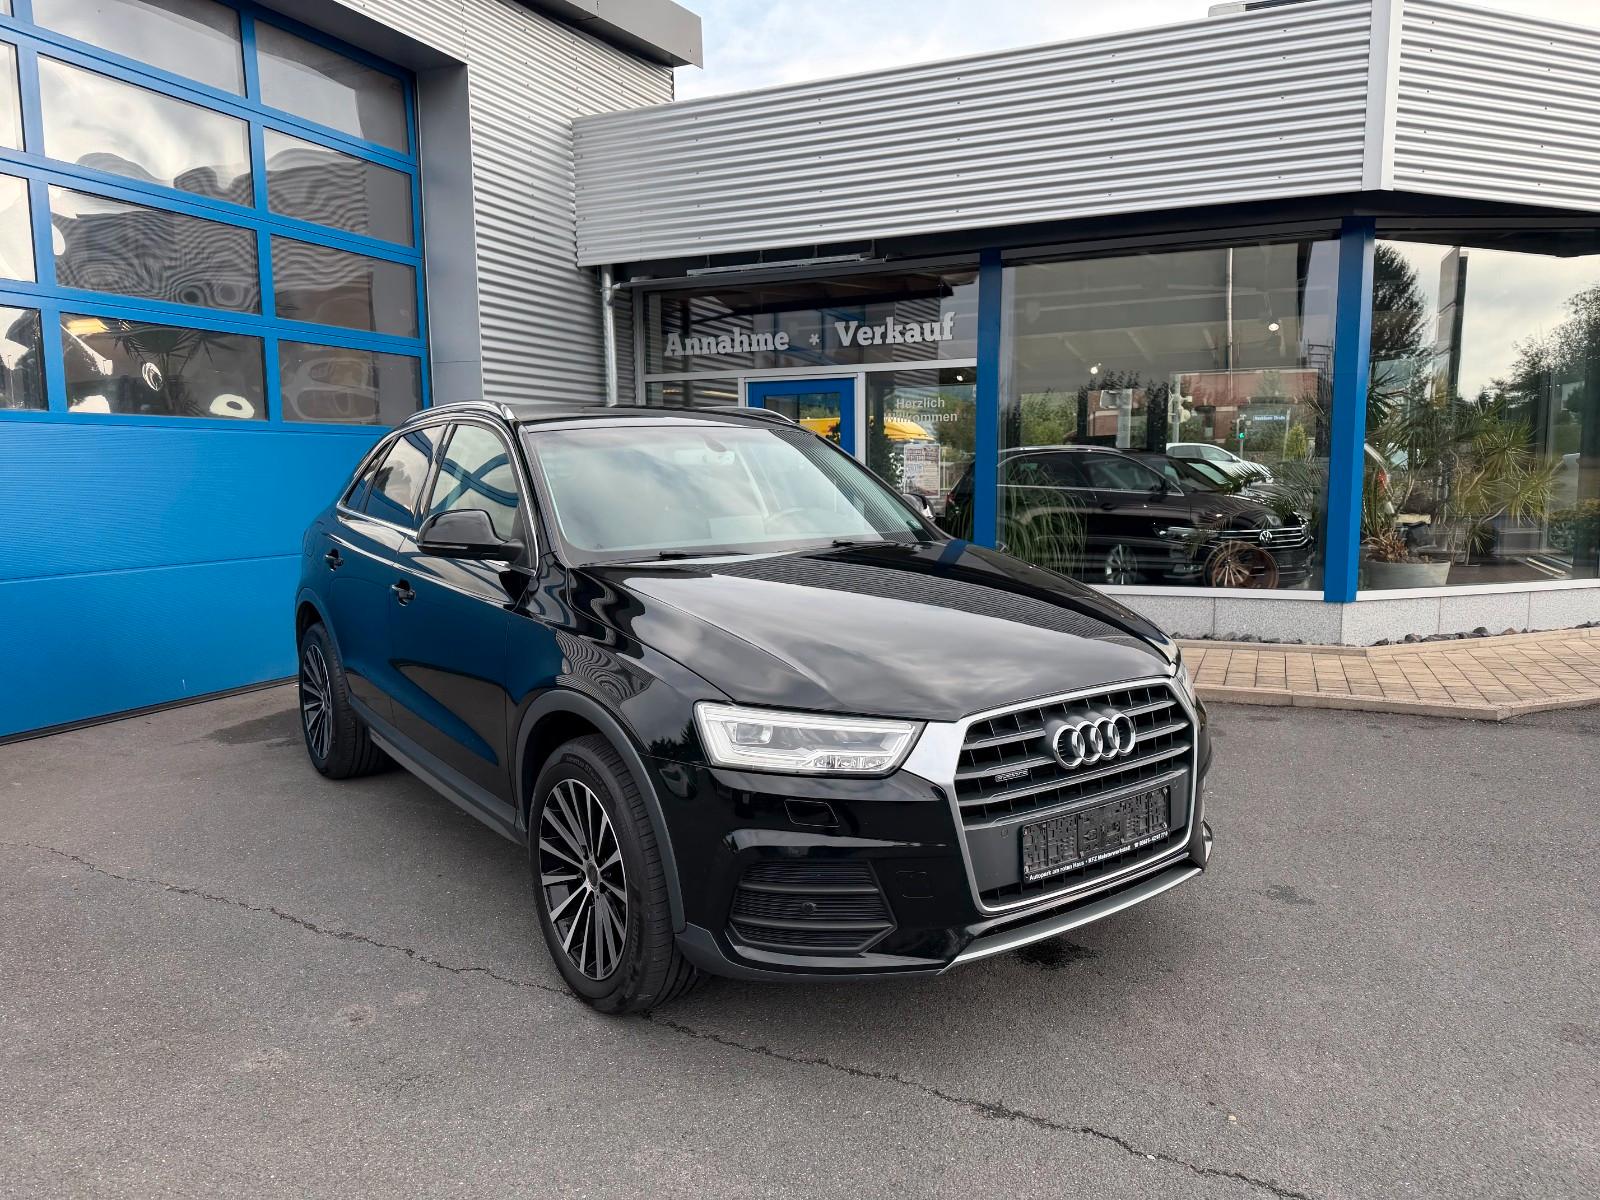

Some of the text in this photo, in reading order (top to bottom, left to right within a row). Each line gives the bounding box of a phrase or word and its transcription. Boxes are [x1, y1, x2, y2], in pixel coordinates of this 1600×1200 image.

[664, 311, 956, 357] Annahme Verkauf
[896, 397, 945, 409] Herzlich
[884, 413, 958, 424] Willkommen
